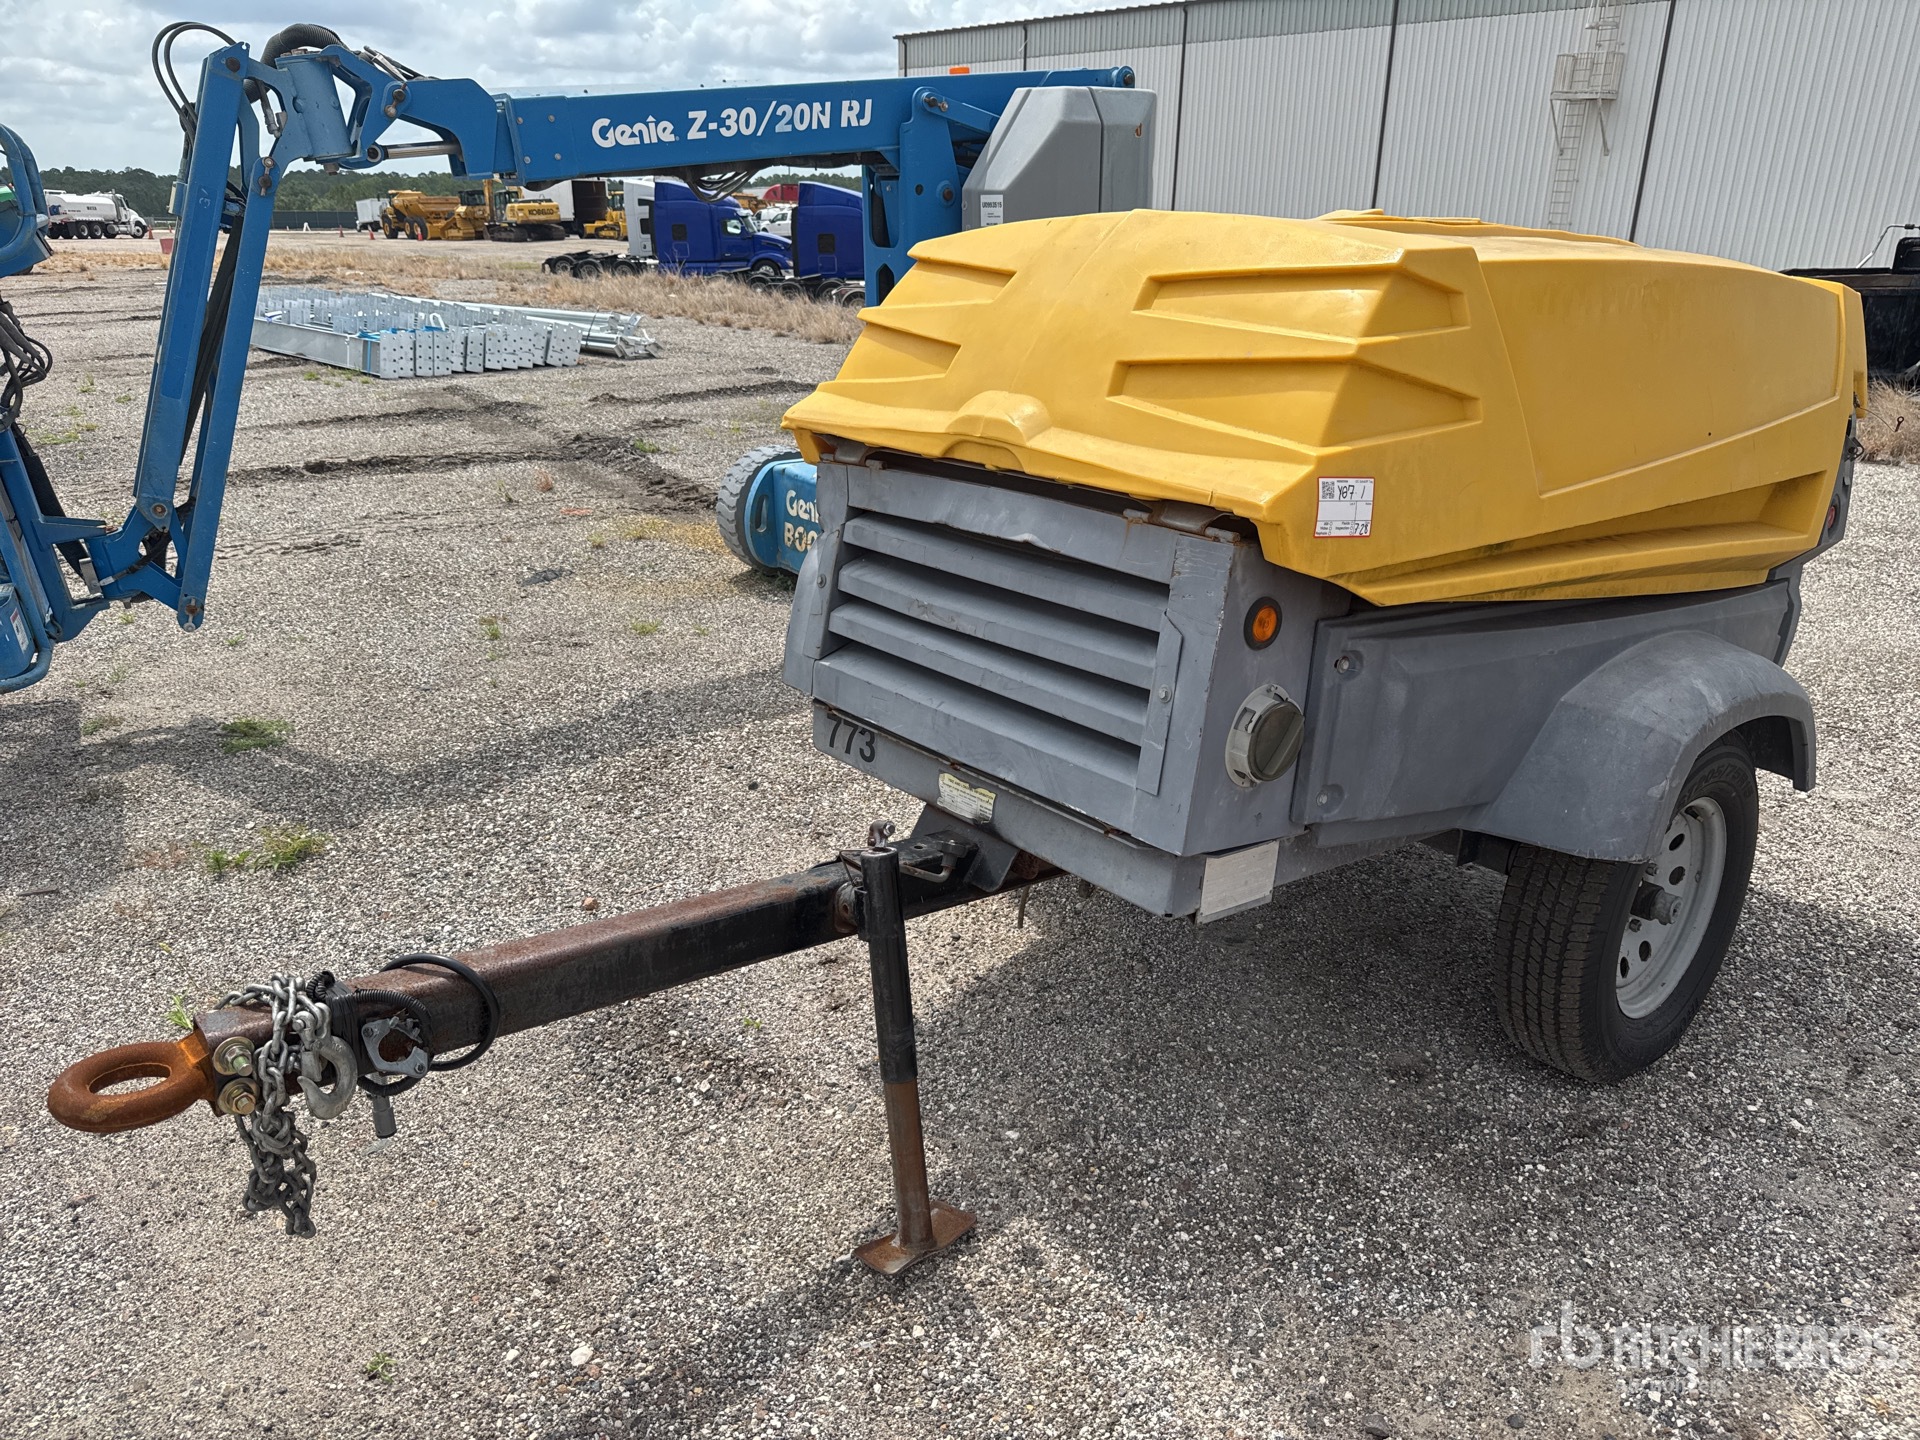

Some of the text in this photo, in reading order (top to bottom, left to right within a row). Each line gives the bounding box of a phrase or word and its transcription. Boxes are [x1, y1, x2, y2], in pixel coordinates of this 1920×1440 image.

[592, 98, 873, 148] Genie Z-30/20N RJ
[785, 489, 820, 524] Geni
[826, 713, 876, 763] 773
